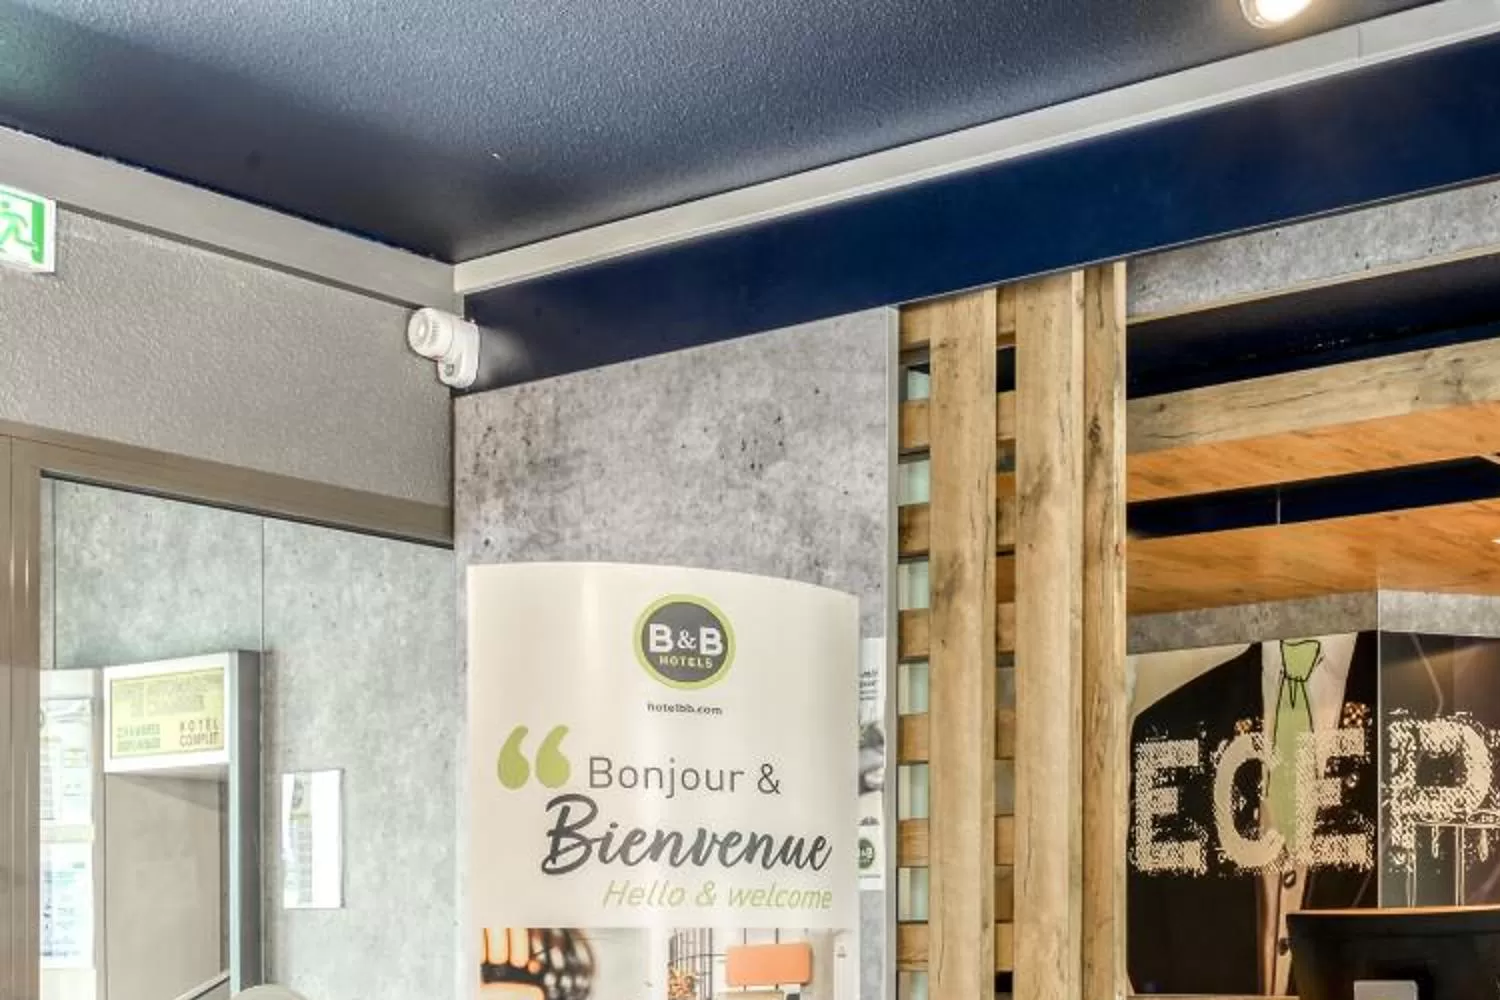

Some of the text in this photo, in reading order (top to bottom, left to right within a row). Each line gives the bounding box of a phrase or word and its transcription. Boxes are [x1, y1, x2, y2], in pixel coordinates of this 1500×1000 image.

[649, 623, 723, 656] B&B
[659, 655, 713, 669] HOTELS
[588, 756, 781, 799] Bonjour &
[541, 793, 833, 876] Bienvenue
[602, 880, 833, 909] Hello & welcome
